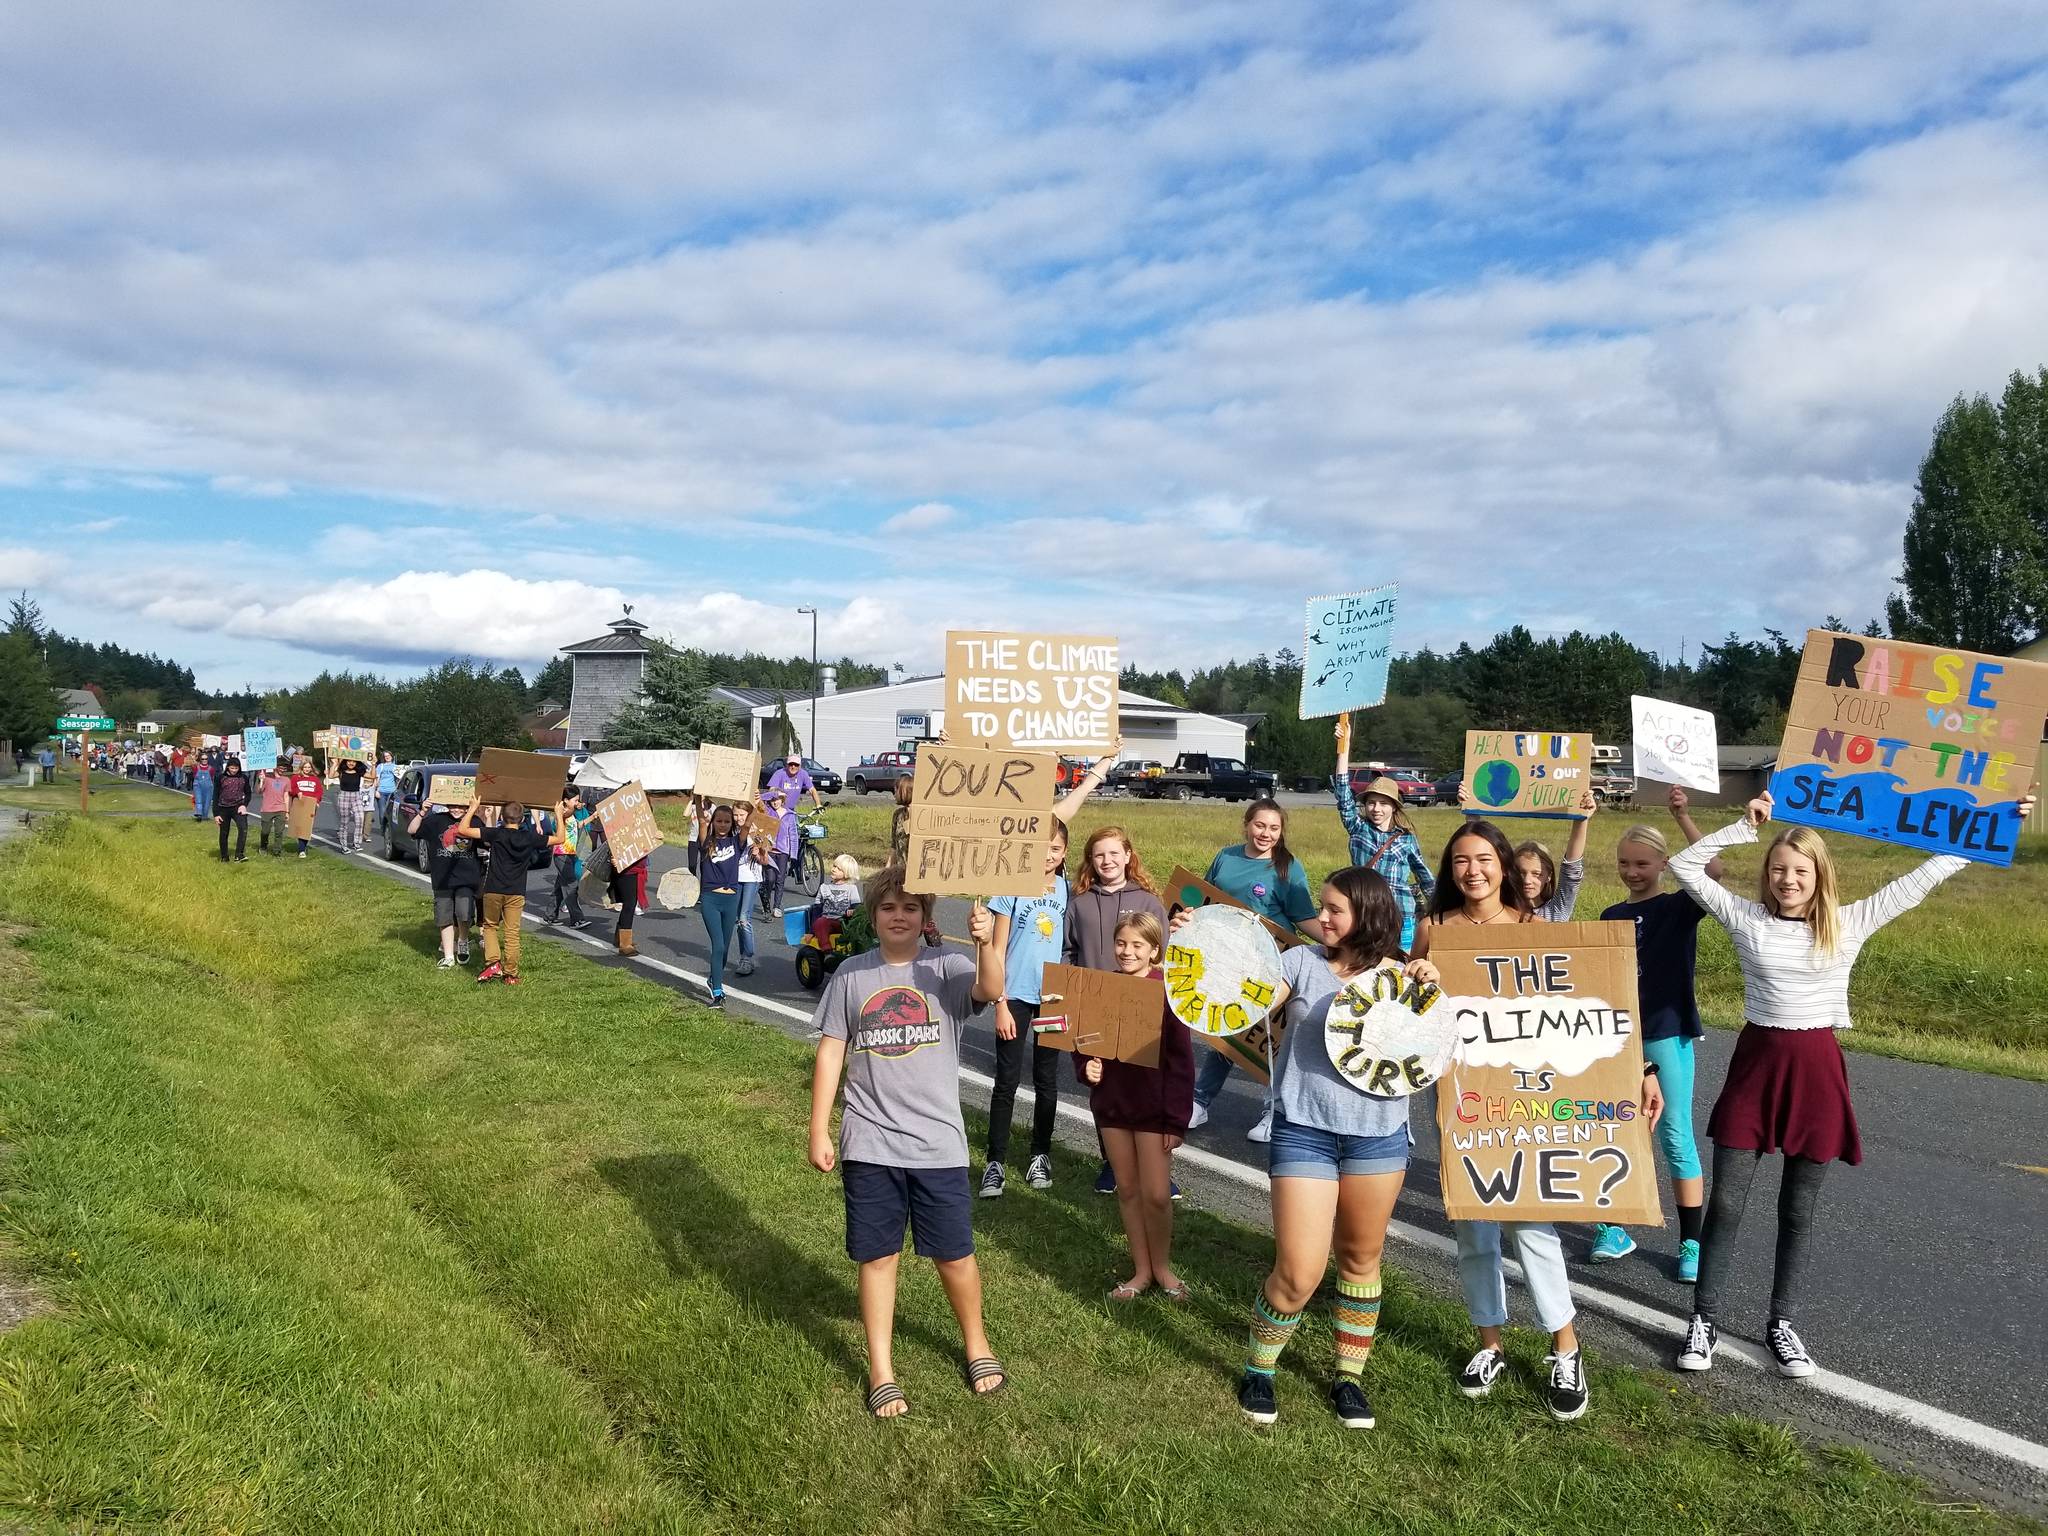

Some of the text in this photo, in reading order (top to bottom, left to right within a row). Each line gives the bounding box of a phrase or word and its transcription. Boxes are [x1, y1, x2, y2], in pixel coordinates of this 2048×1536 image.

[1322, 599, 1397, 625] CLIMATE
[1336, 598, 1361, 609] THE
[956, 639, 1119, 672] THE CLIMATE
[1336, 639, 1366, 652] WHY
[1369, 645, 1391, 660] WE
[1825, 637, 2004, 709] RAISE
[957, 675, 1113, 710] NEEDS US
[61, 719, 101, 730] Seascape
[899, 716, 923, 725] UNITED
[963, 708, 1109, 740] TO CHANGE
[1831, 692, 2022, 739] YOUR VOICE
[367, 752, 374, 762] B
[1474, 733, 1580, 760] HER FUTURE
[1811, 727, 2016, 792] NOT THE
[924, 753, 1035, 803] YOUR
[1530, 764, 1546, 778] is
[600, 801, 617, 822] IF
[619, 791, 642, 810] YOU
[1522, 781, 1578, 809] FUTURE
[916, 809, 960, 831] Climate
[963, 812, 990, 826] change
[1000, 816, 1040, 836] OUR
[1786, 775, 2010, 852] SEA LEVEL
[917, 836, 1034, 881] FUTURE
[1033, 899, 1047, 909] FOR
[1049, 899, 1061, 911] THE
[1166, 944, 1275, 1033] ENRICH
[1474, 954, 1575, 995] THE
[855, 1024, 940, 1050] JURASSIC PARK
[1456, 1008, 1631, 1044] CLIMATE
[1511, 1068, 1556, 1093] IS
[1456, 1090, 1638, 1124] CHANGING
[1461, 1146, 1633, 1209] WE?
